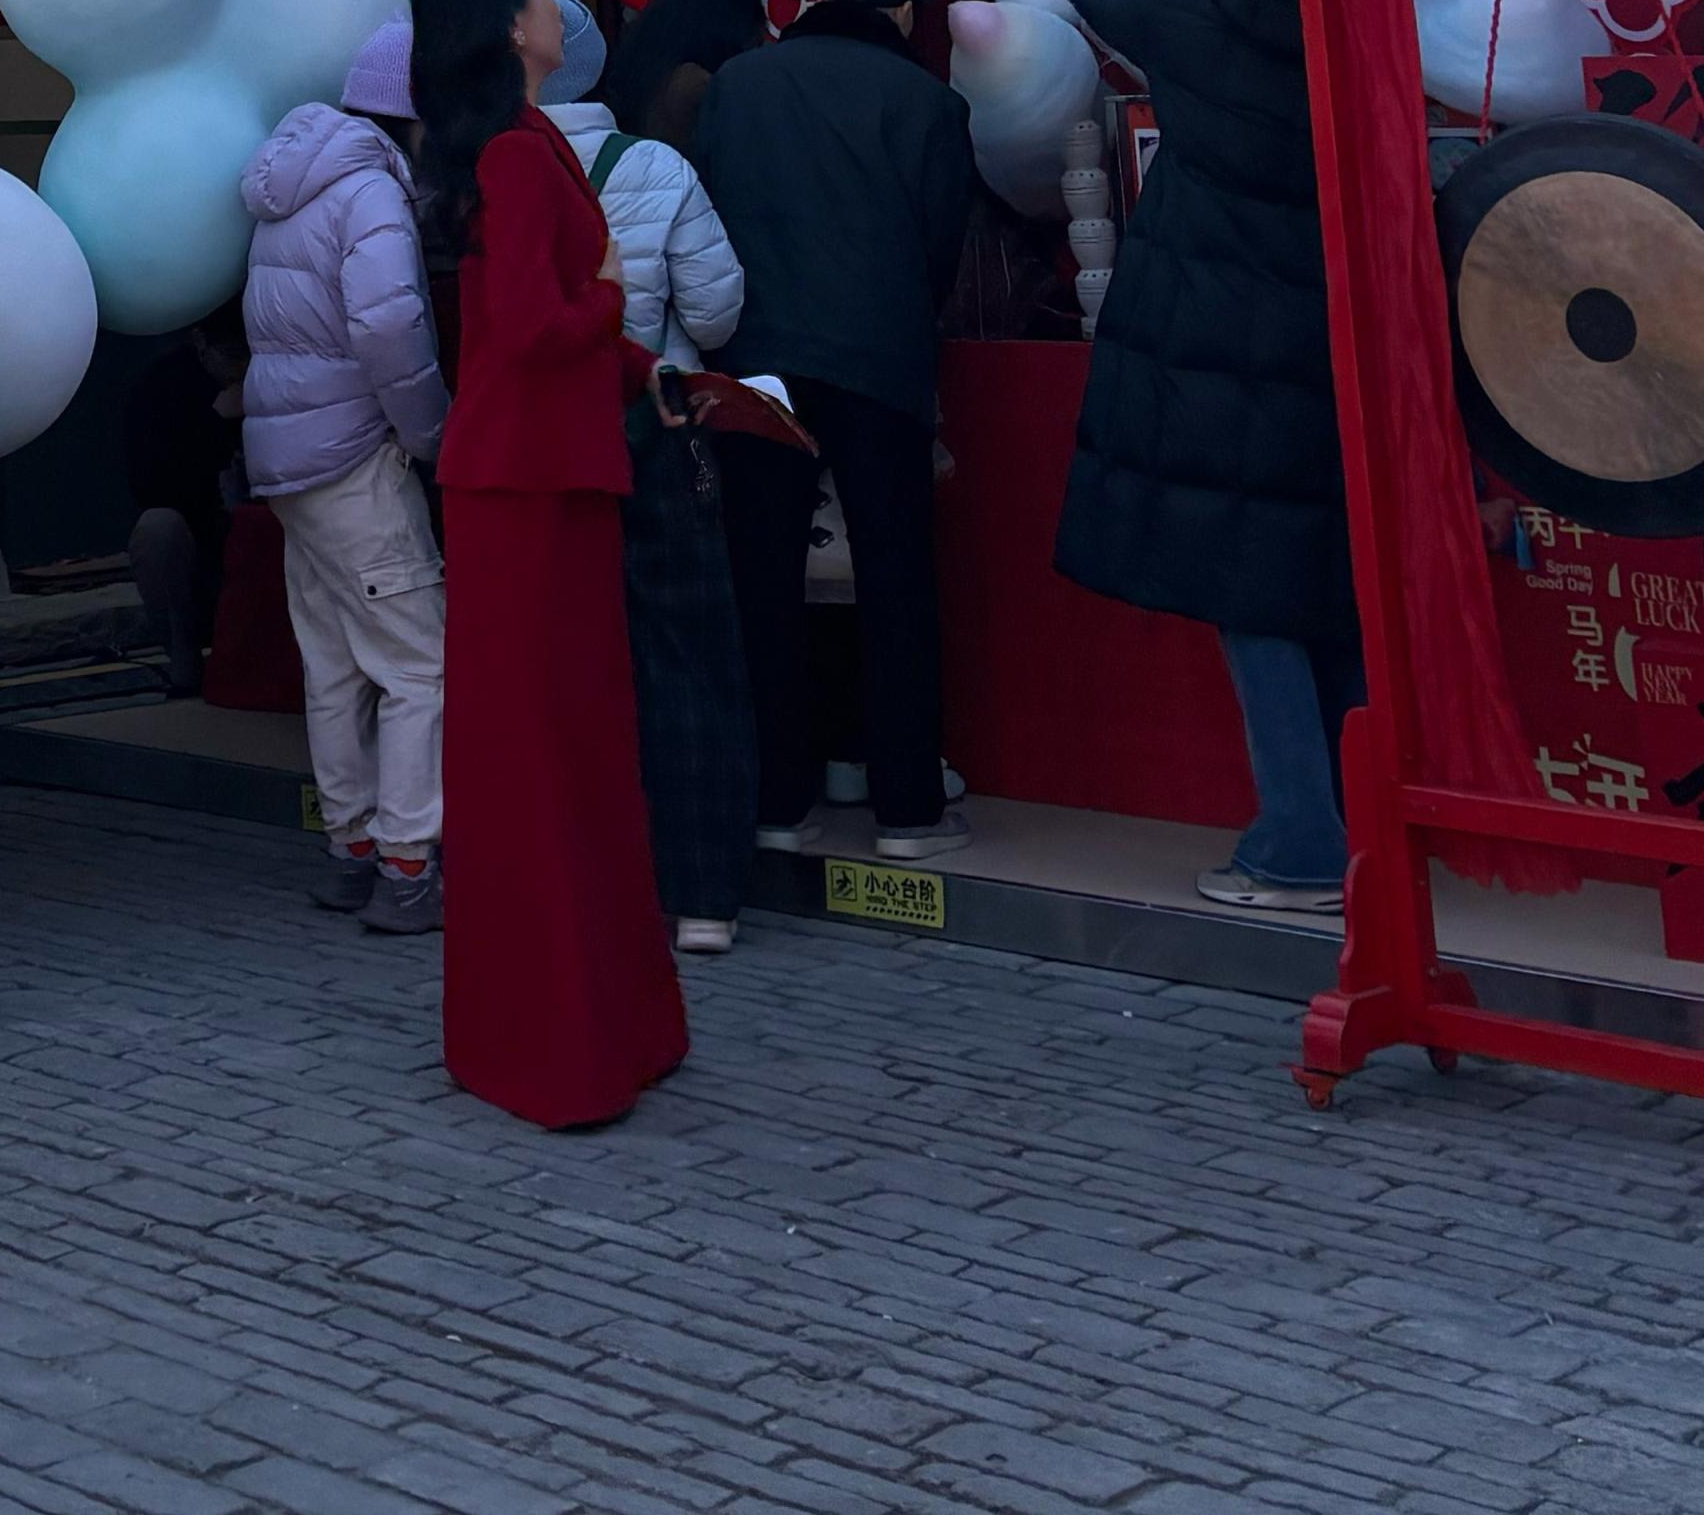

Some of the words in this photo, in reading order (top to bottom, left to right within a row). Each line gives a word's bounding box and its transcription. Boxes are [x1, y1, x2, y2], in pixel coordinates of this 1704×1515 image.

[1545, 559, 1593, 580] Spring
[1633, 597, 1702, 635] LUCK
[1566, 604, 1611, 693] 马年
[864, 870, 937, 903] 小心台阶
